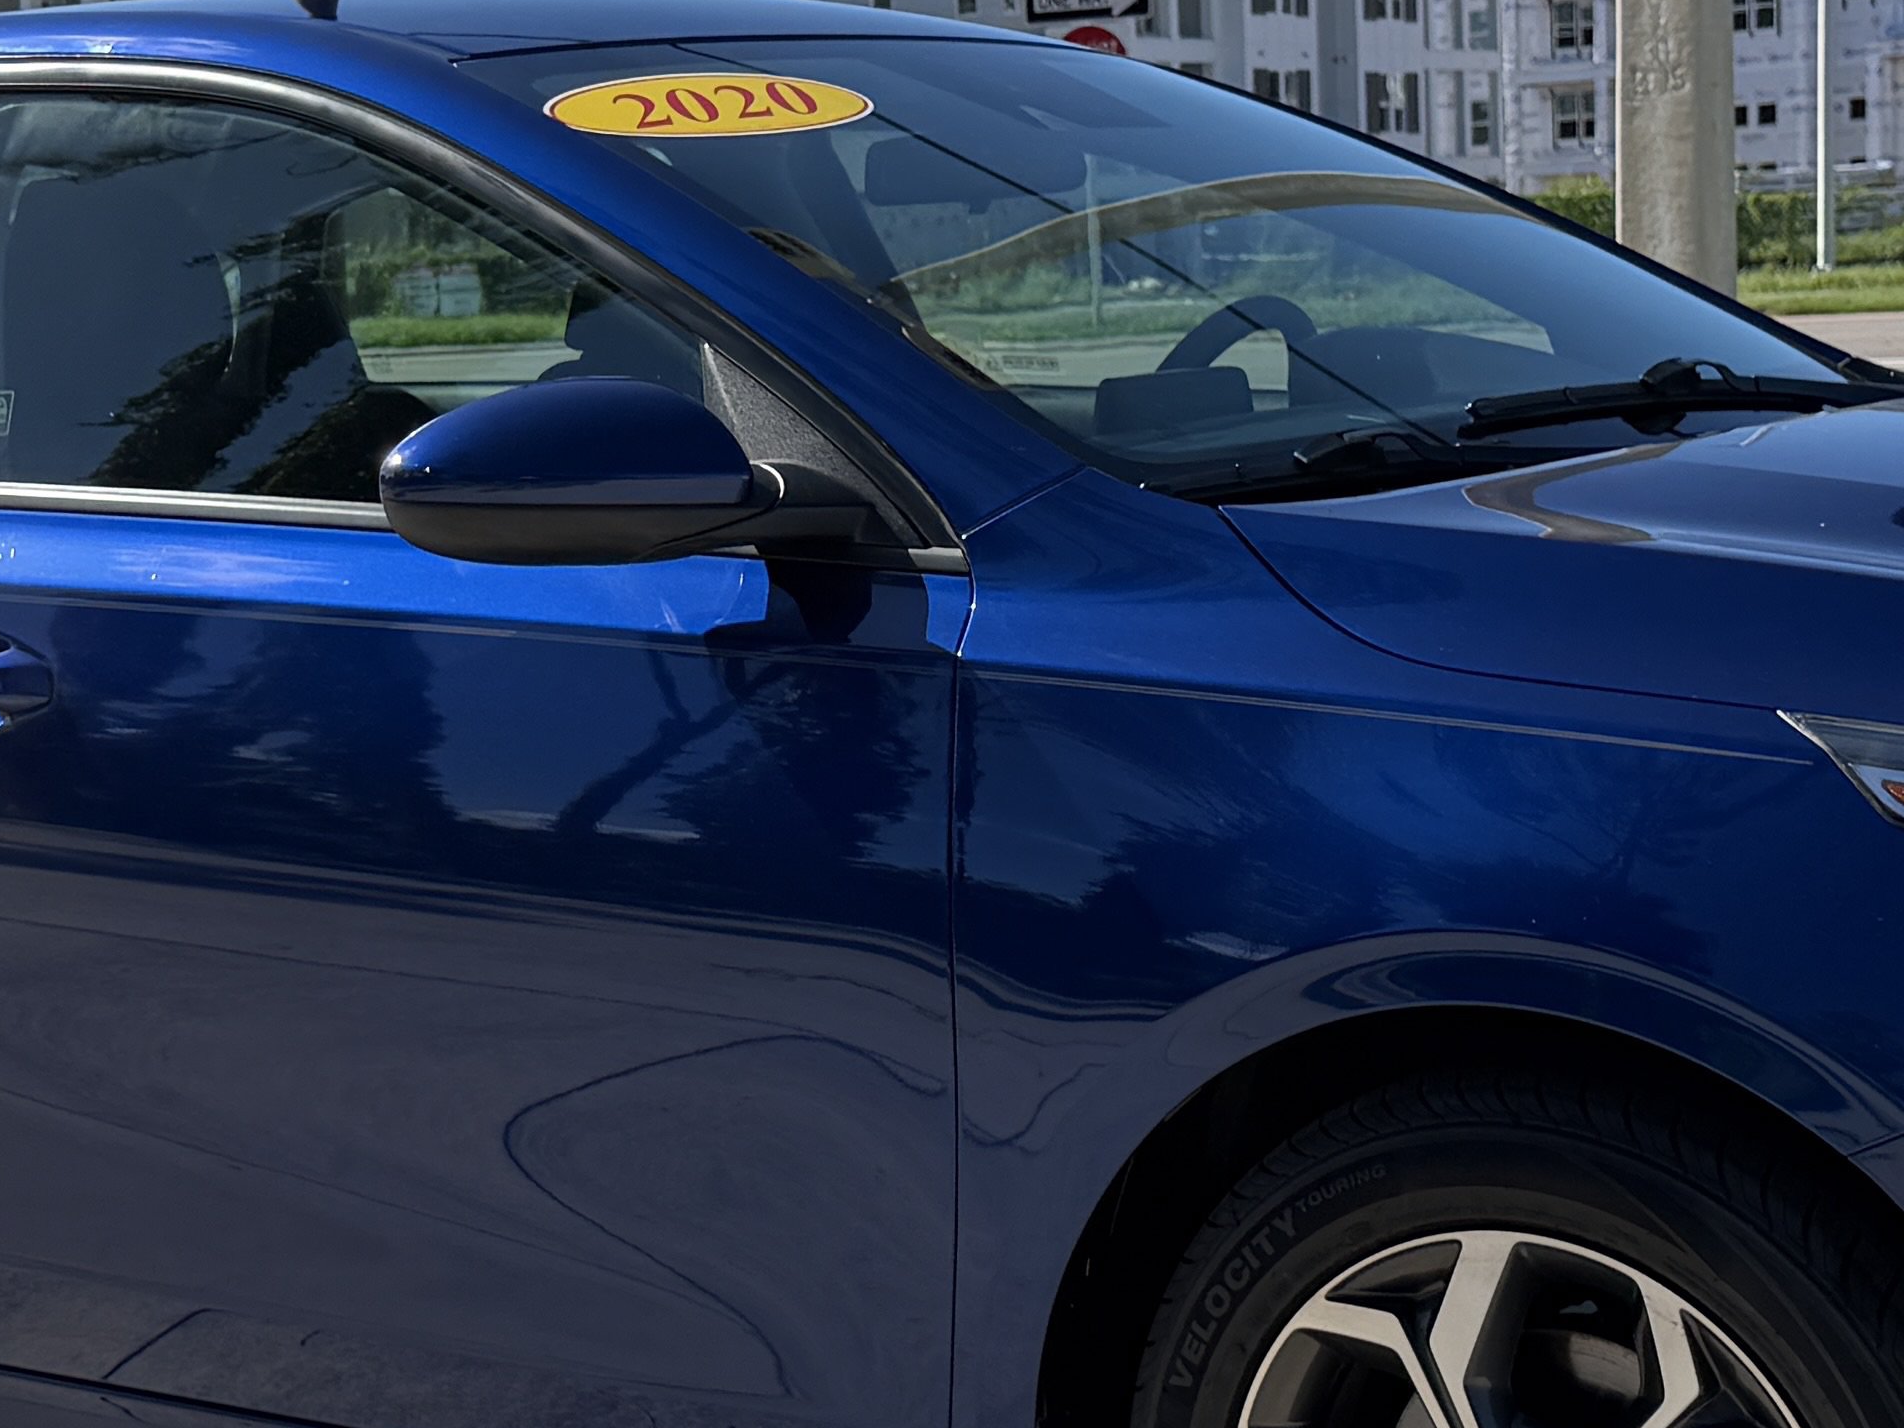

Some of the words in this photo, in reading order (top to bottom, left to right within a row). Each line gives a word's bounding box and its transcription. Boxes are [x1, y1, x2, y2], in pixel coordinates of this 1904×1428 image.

[612, 80, 819, 130] 2020
[1167, 1206, 1298, 1389] VELOCITY
[1298, 1163, 1388, 1214] TOURING
